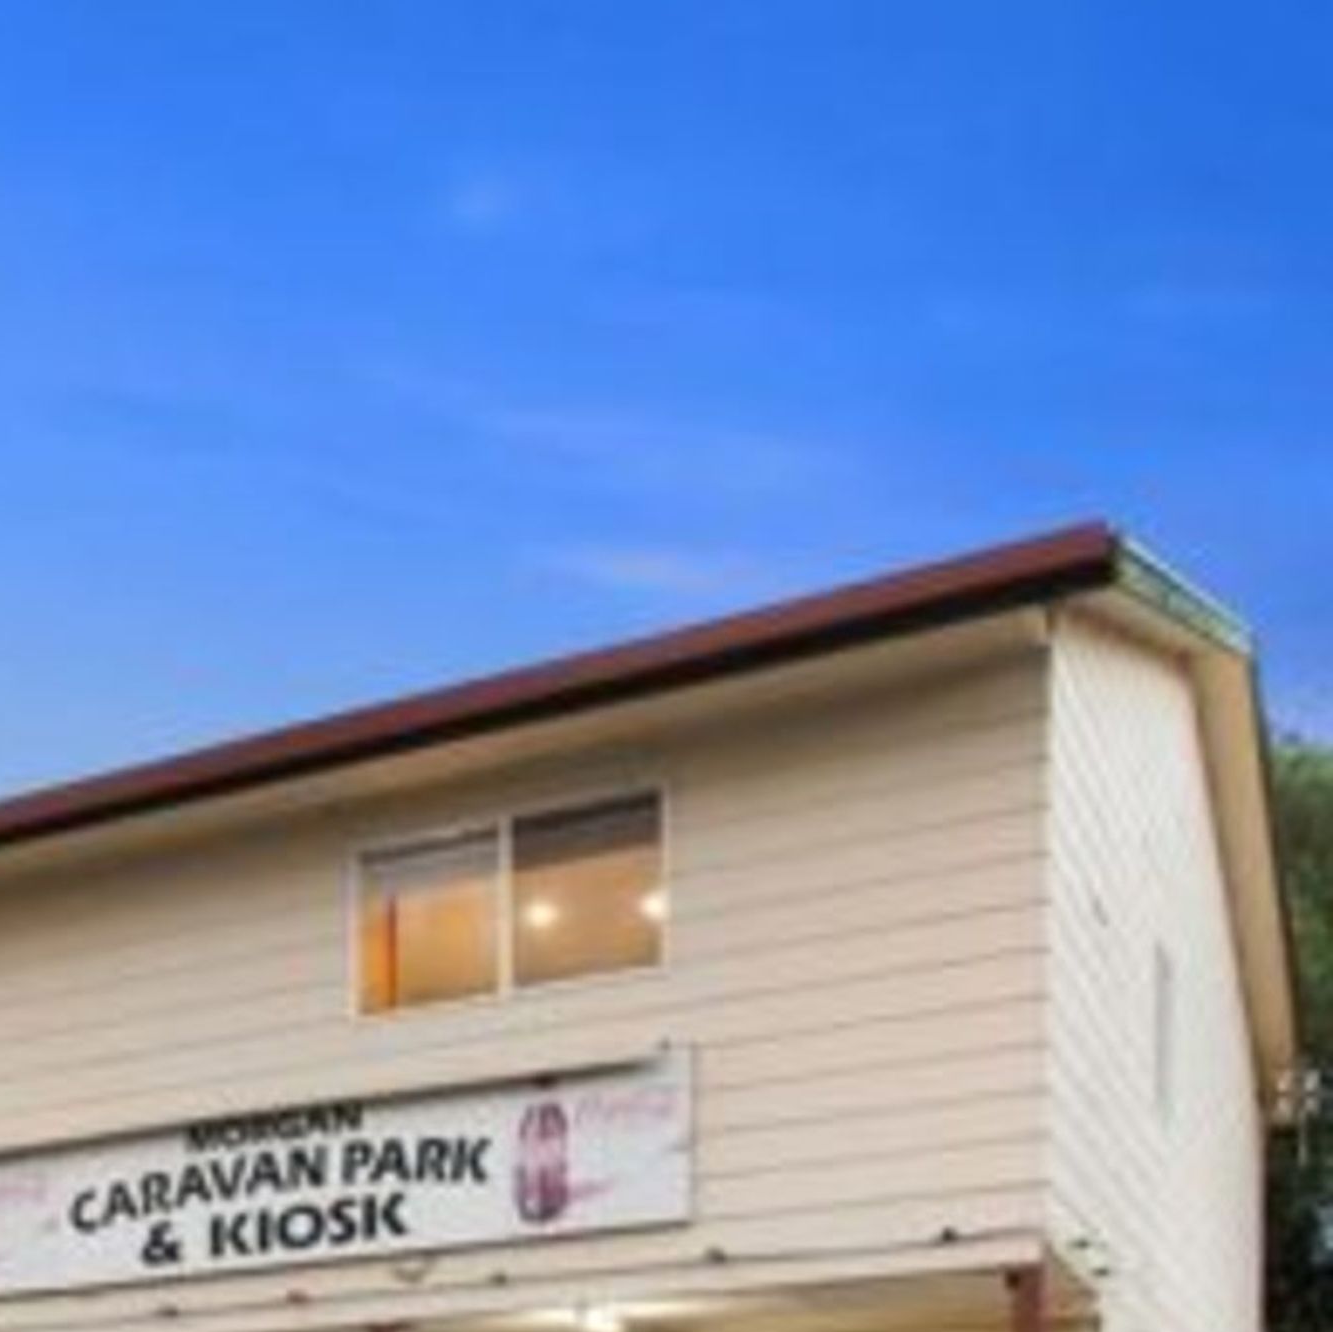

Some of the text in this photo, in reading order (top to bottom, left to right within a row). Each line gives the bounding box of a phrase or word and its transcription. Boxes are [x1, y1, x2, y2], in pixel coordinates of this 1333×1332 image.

[186, 1103, 365, 1151] MORGAN
[69, 1144, 328, 1233] CARAVAN
[340, 1136, 493, 1184] PARK
[140, 1192, 409, 1264] & KIOSK
